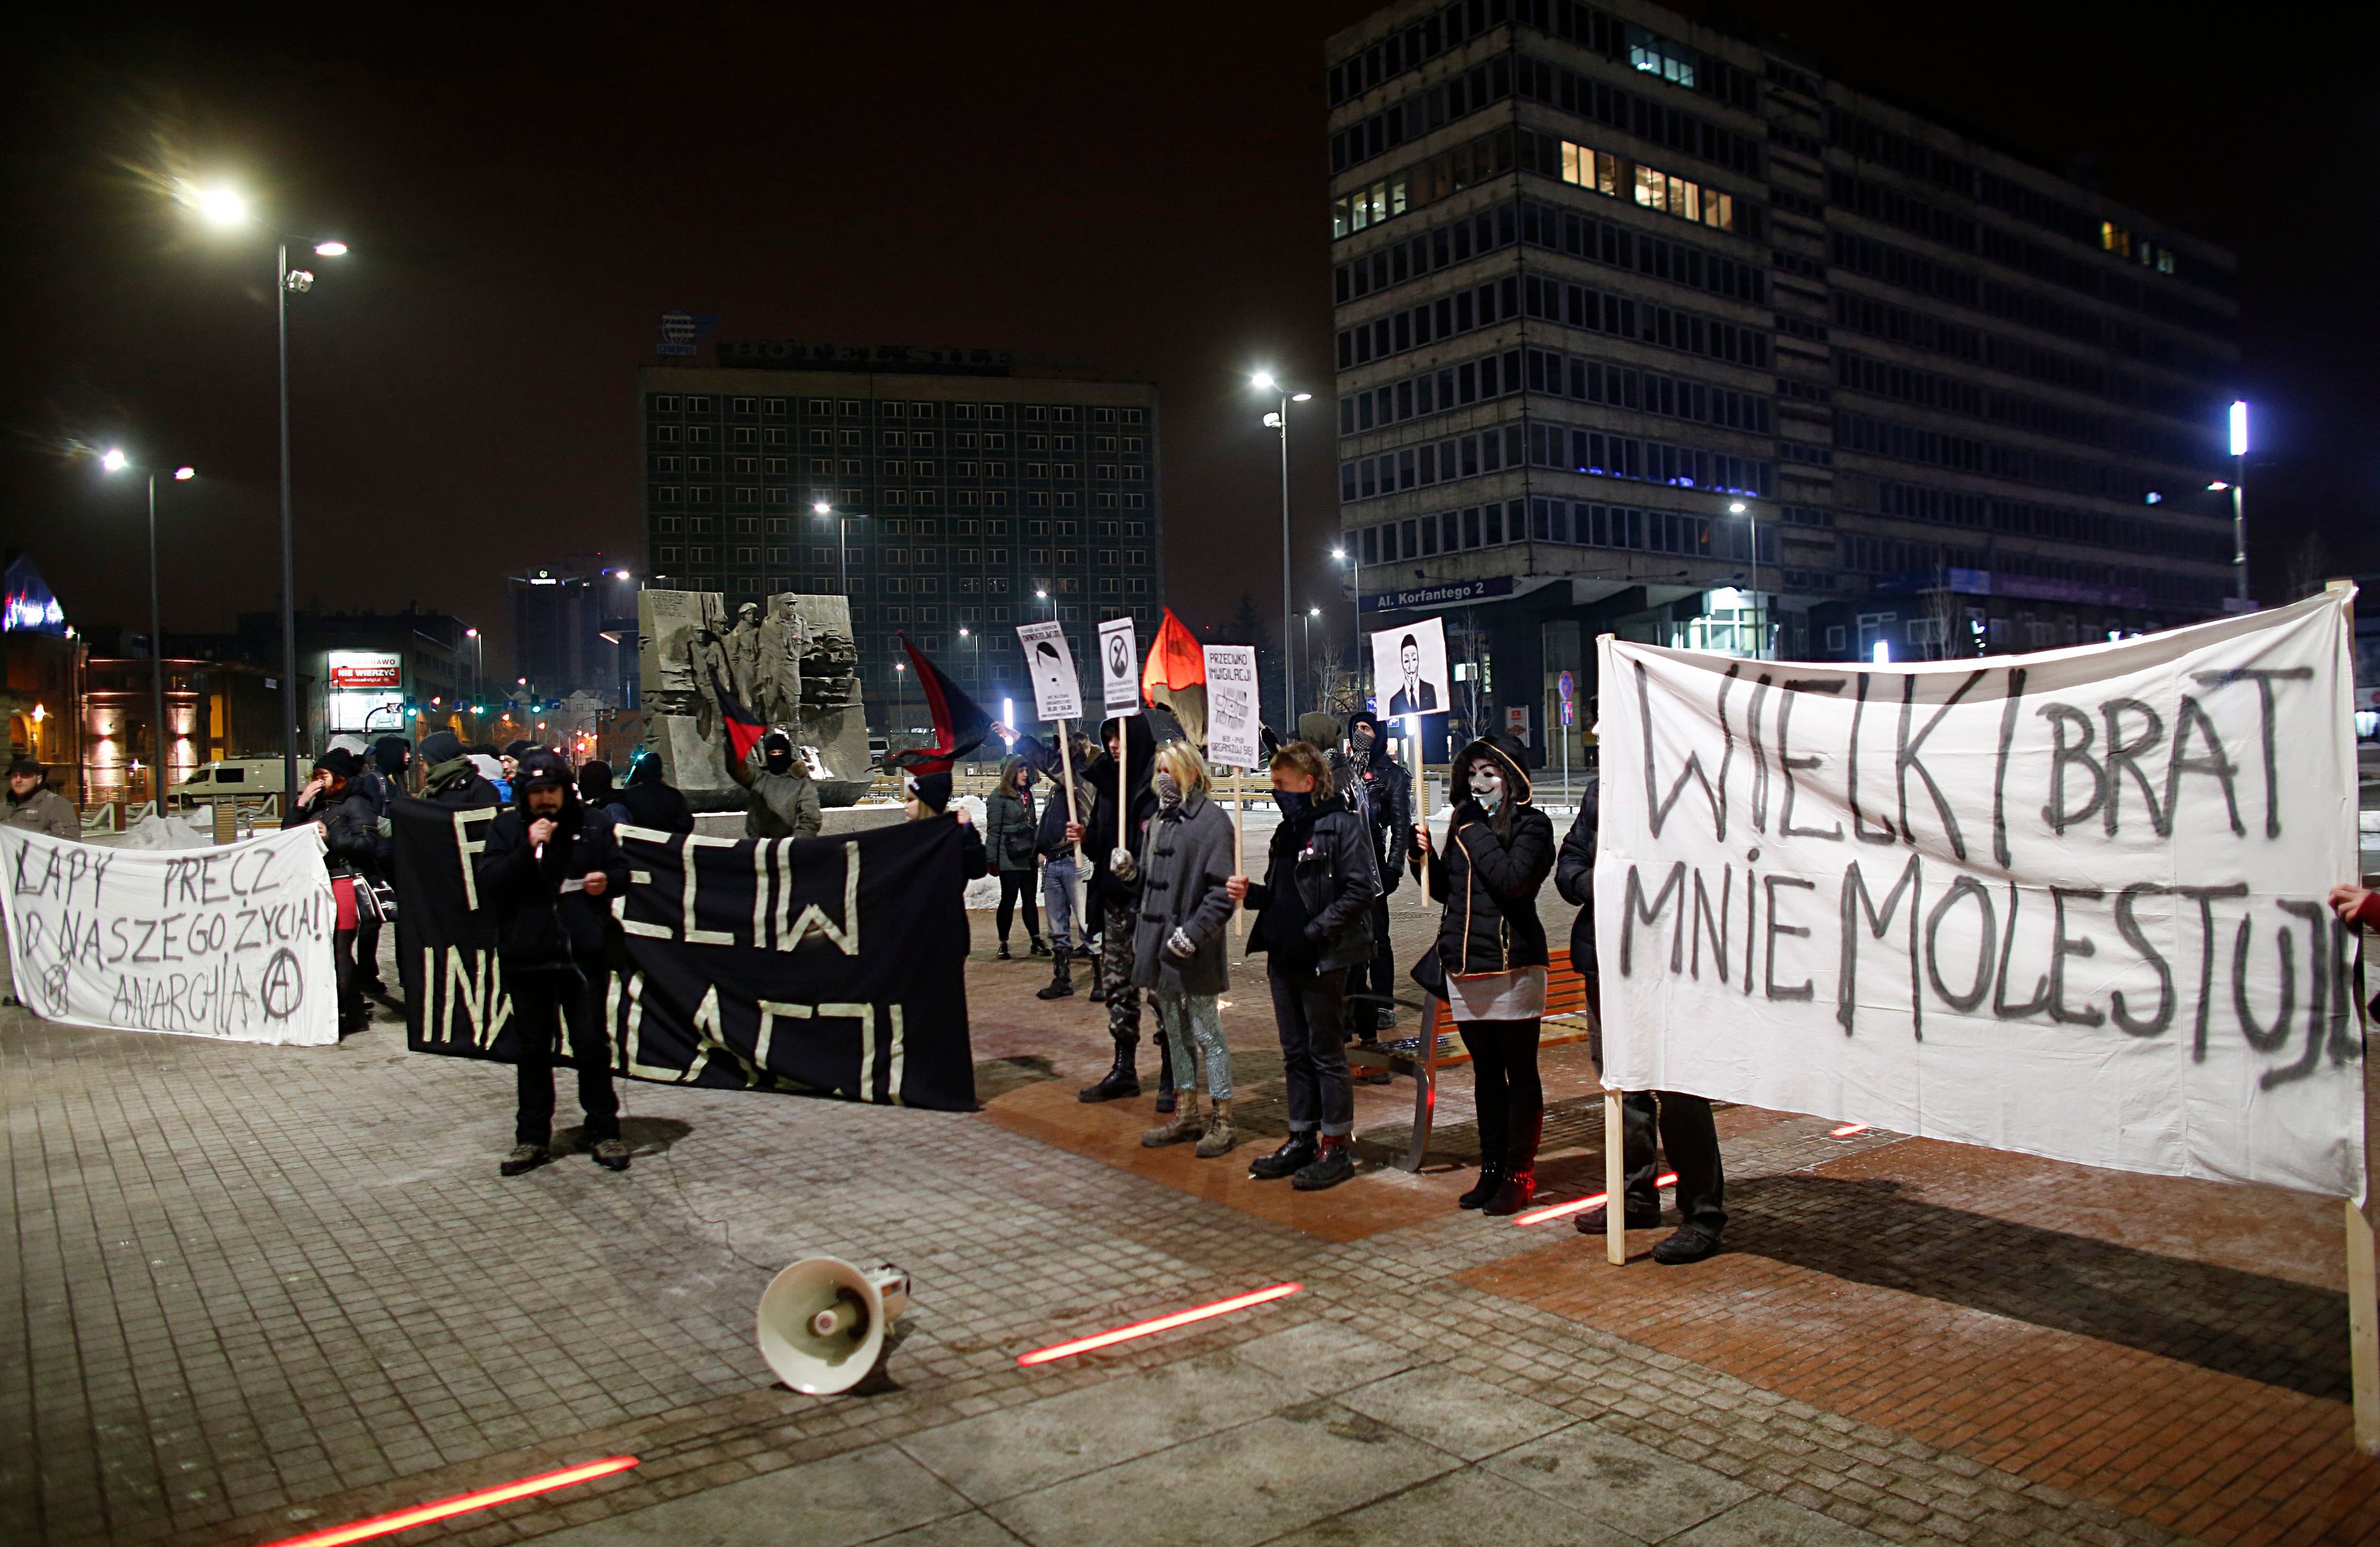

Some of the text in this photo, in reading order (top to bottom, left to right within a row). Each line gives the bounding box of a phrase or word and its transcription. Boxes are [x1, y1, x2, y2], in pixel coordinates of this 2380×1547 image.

[1378, 582, 1484, 607] Al. Korfantego 2
[1210, 653, 1248, 666] PRZECIWKO
[355, 668, 395, 676] WIERZYĆ
[1209, 668, 1251, 681] INWIGILACJI
[1211, 742, 1242, 754] ORGANIZUJ
[1633, 659, 2312, 868] WIELKI BRAT
[15, 839, 280, 909] ŁAPY PRECZ
[60, 909, 226, 972] NASZEGO
[234, 890, 323, 953] ŻYCIA!
